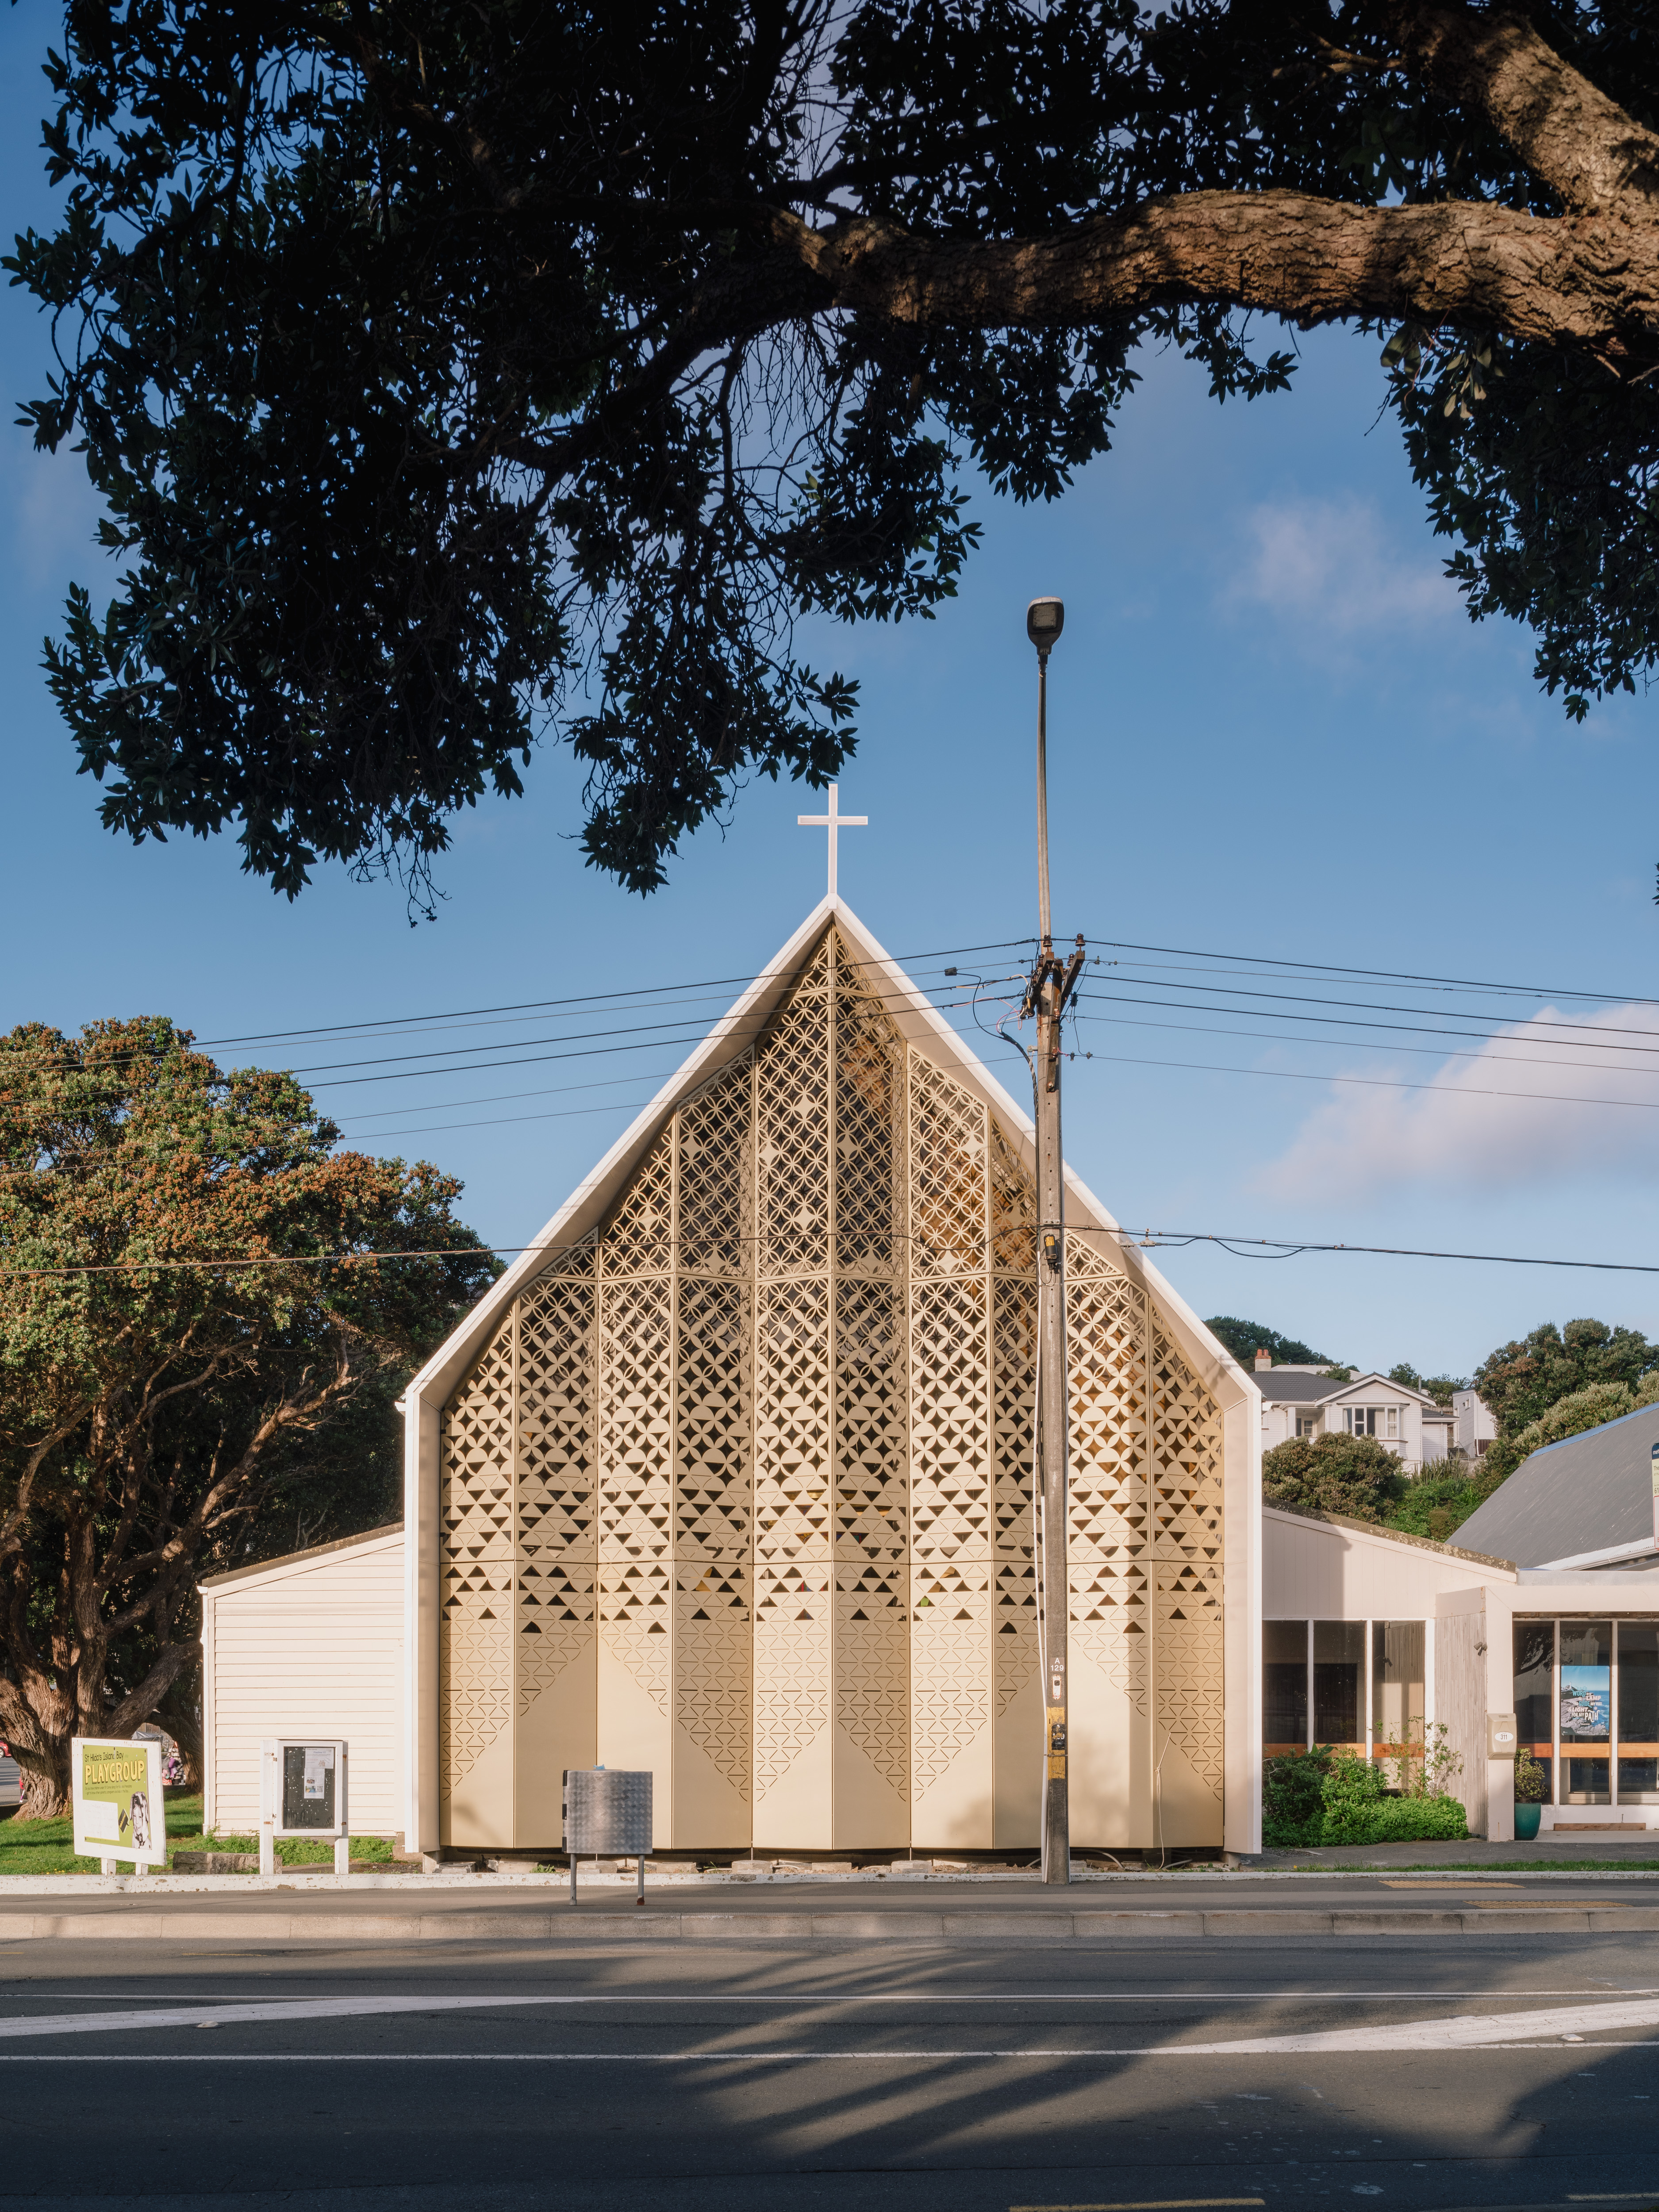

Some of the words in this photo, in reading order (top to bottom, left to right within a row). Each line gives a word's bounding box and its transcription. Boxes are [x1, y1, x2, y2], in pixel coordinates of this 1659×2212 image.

[1579, 1699, 1592, 1708] GUIDE
[1585, 1710, 1600, 1722] PATH
[90, 1753, 102, 1762] Hilda's
[103, 1752, 115, 1760] Island
[85, 1760, 144, 1785] PLAYGROUP
